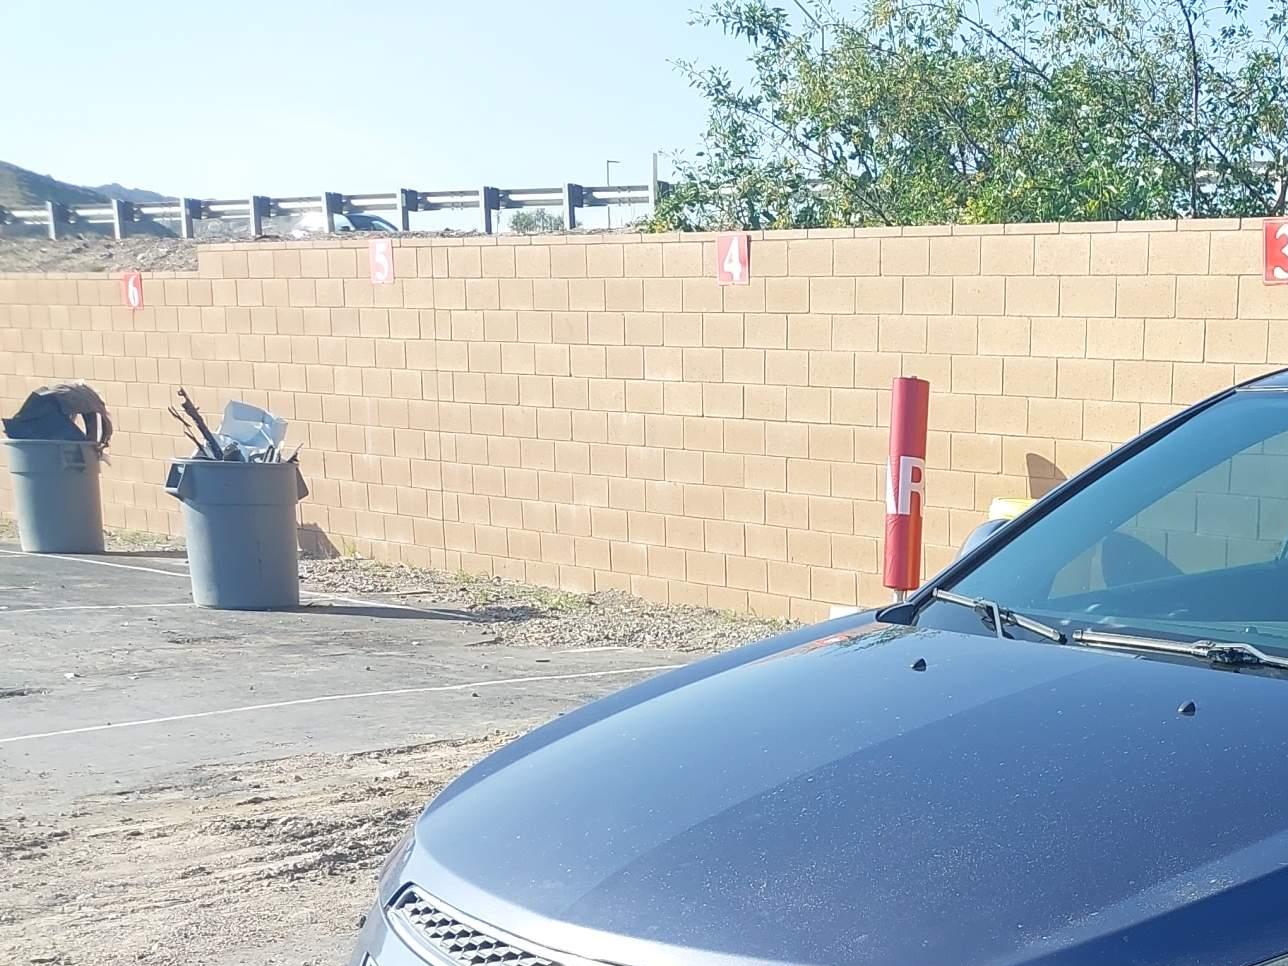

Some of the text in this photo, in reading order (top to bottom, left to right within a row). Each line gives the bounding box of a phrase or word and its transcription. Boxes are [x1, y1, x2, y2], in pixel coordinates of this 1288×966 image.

[374, 241, 389, 281] 5
[723, 236, 742, 281] 4
[128, 275, 139, 306] 6
